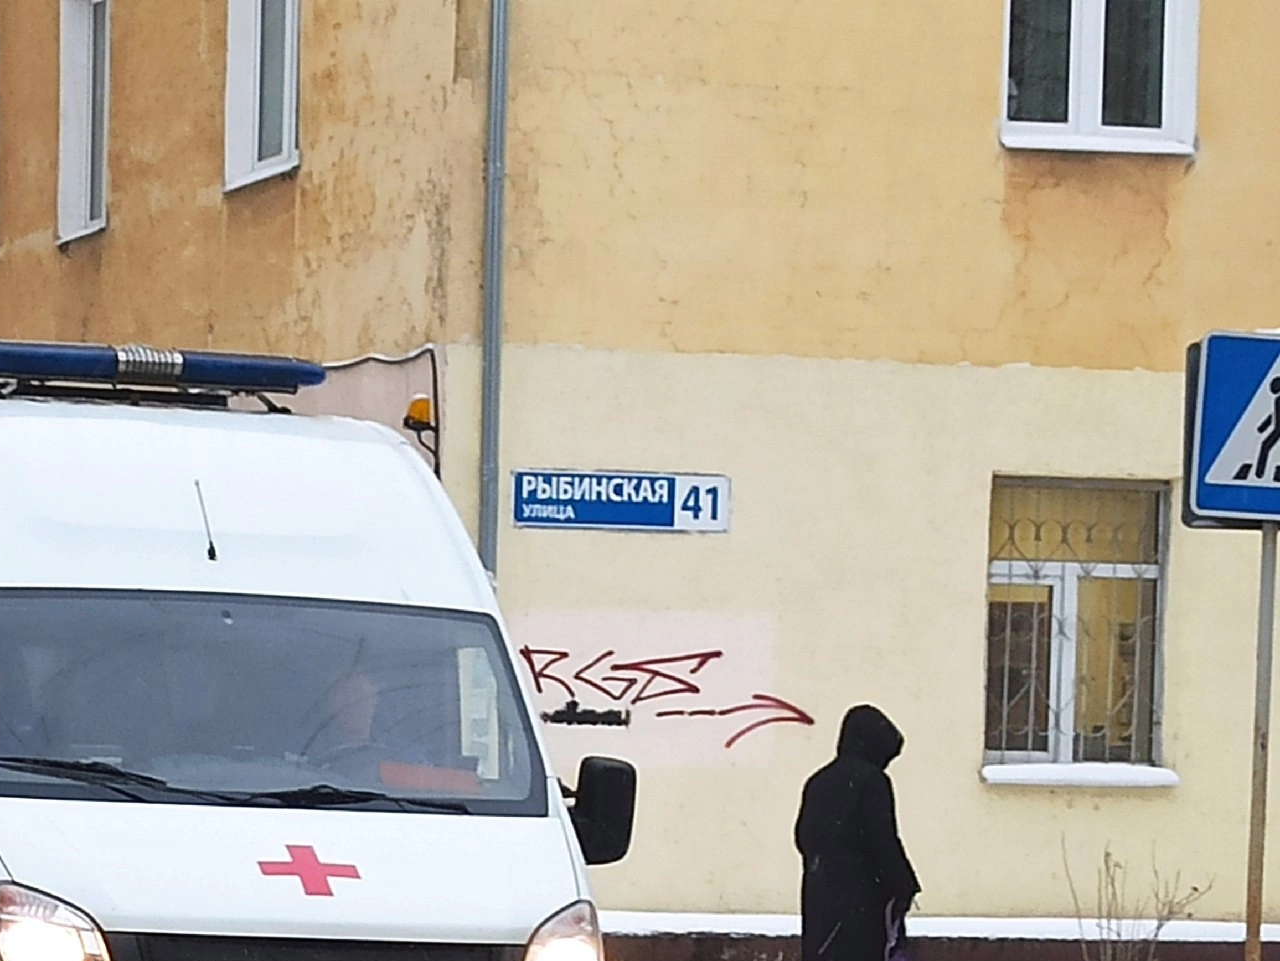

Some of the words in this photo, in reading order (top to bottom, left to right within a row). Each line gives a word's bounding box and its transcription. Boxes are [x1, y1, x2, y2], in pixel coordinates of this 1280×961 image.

[522, 475, 669, 504] РЫБИНСКАЯ
[681, 484, 720, 521] 41
[522, 503, 576, 521] УЛИЦА
